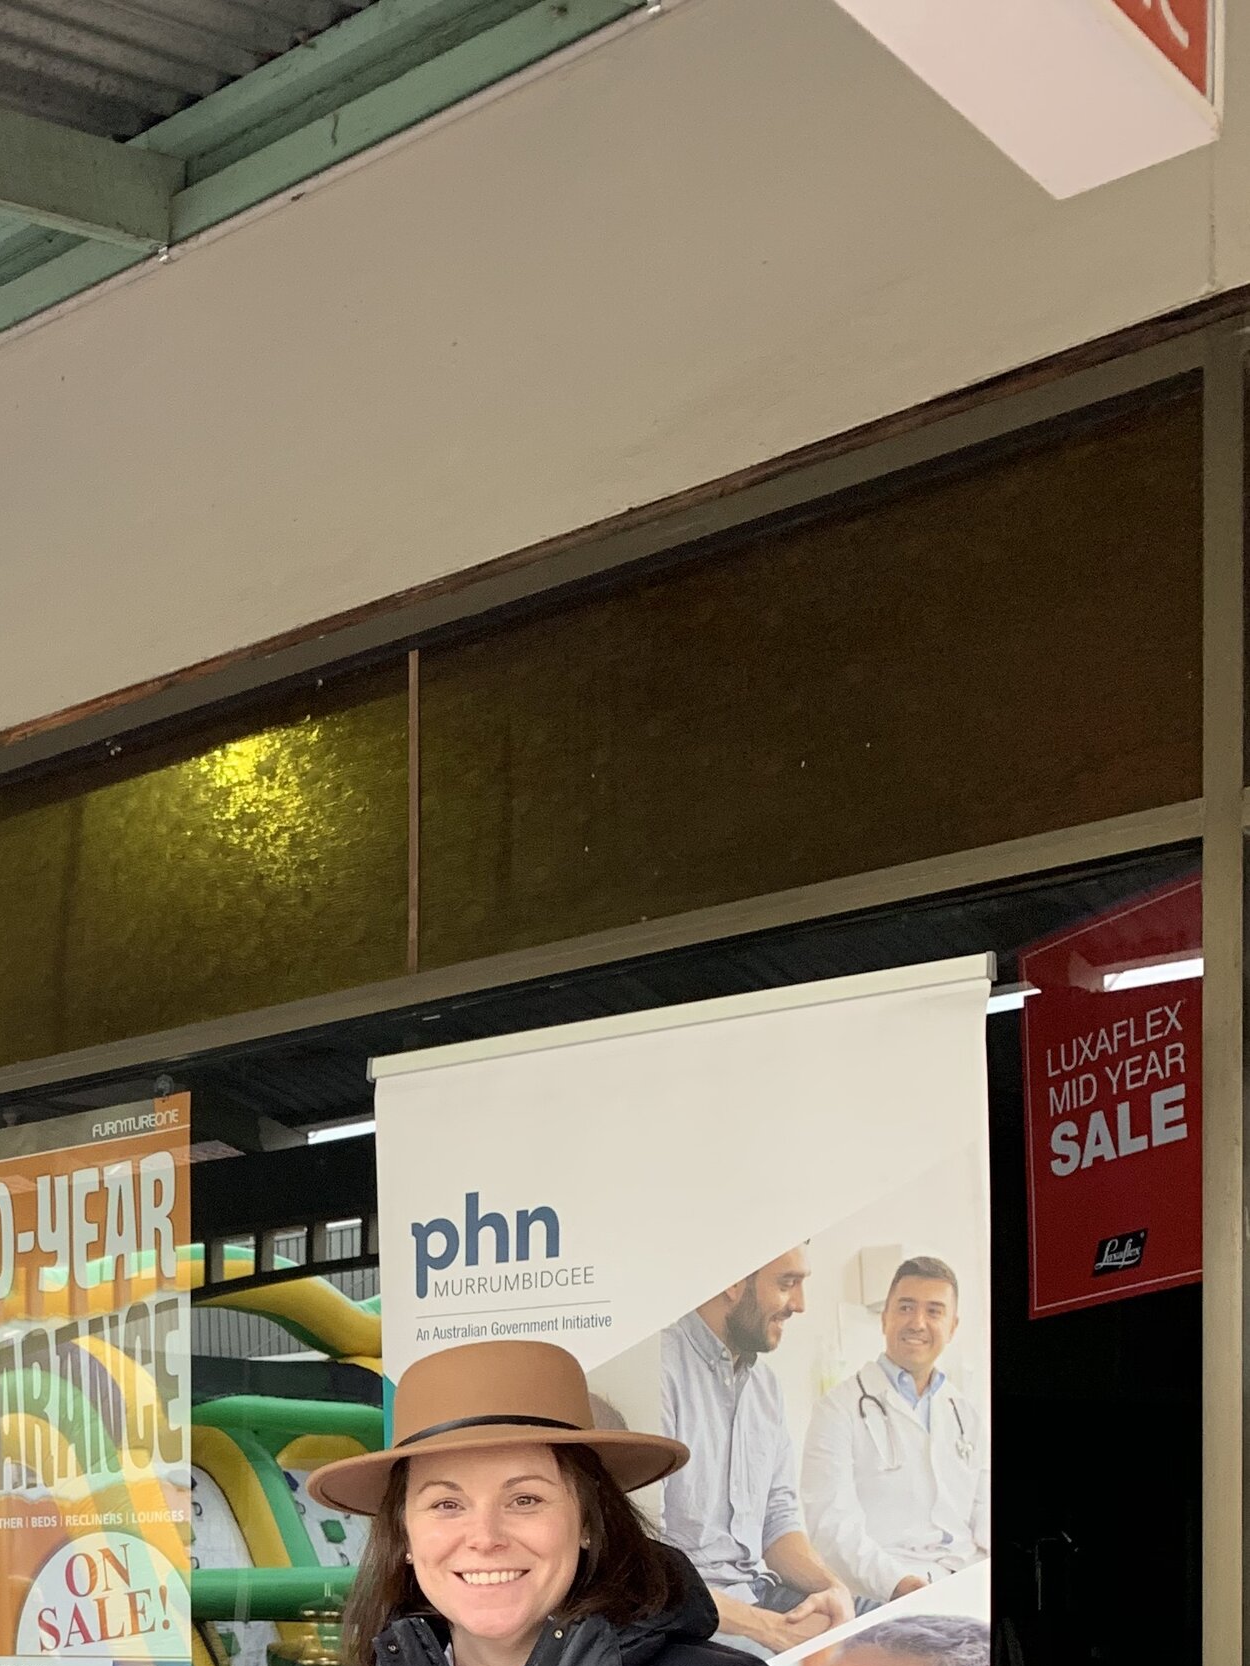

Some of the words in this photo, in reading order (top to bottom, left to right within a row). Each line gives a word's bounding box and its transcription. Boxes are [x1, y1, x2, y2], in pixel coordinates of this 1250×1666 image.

[1047, 1000, 1183, 1077] LUXAFLEX
[1049, 1073, 1097, 1117] MID
[1105, 1042, 1186, 1095] YEAR
[1050, 1083, 1188, 1177] SALE
[411, 1191, 559, 1299] phn
[434, 1266, 594, 1298] MURRUMBIDGEE
[416, 1328, 430, 1341] An
[432, 1323, 488, 1340] Australian
[491, 1317, 558, 1336] Government
[562, 1313, 612, 1331] Initiative
[31, 1515, 57, 1528] BEDS
[65, 1512, 123, 1527] RECLINERS
[131, 1510, 184, 1524] LOUNGES
[65, 1543, 131, 1597] ON
[37, 1584, 170, 1653] SALE!
